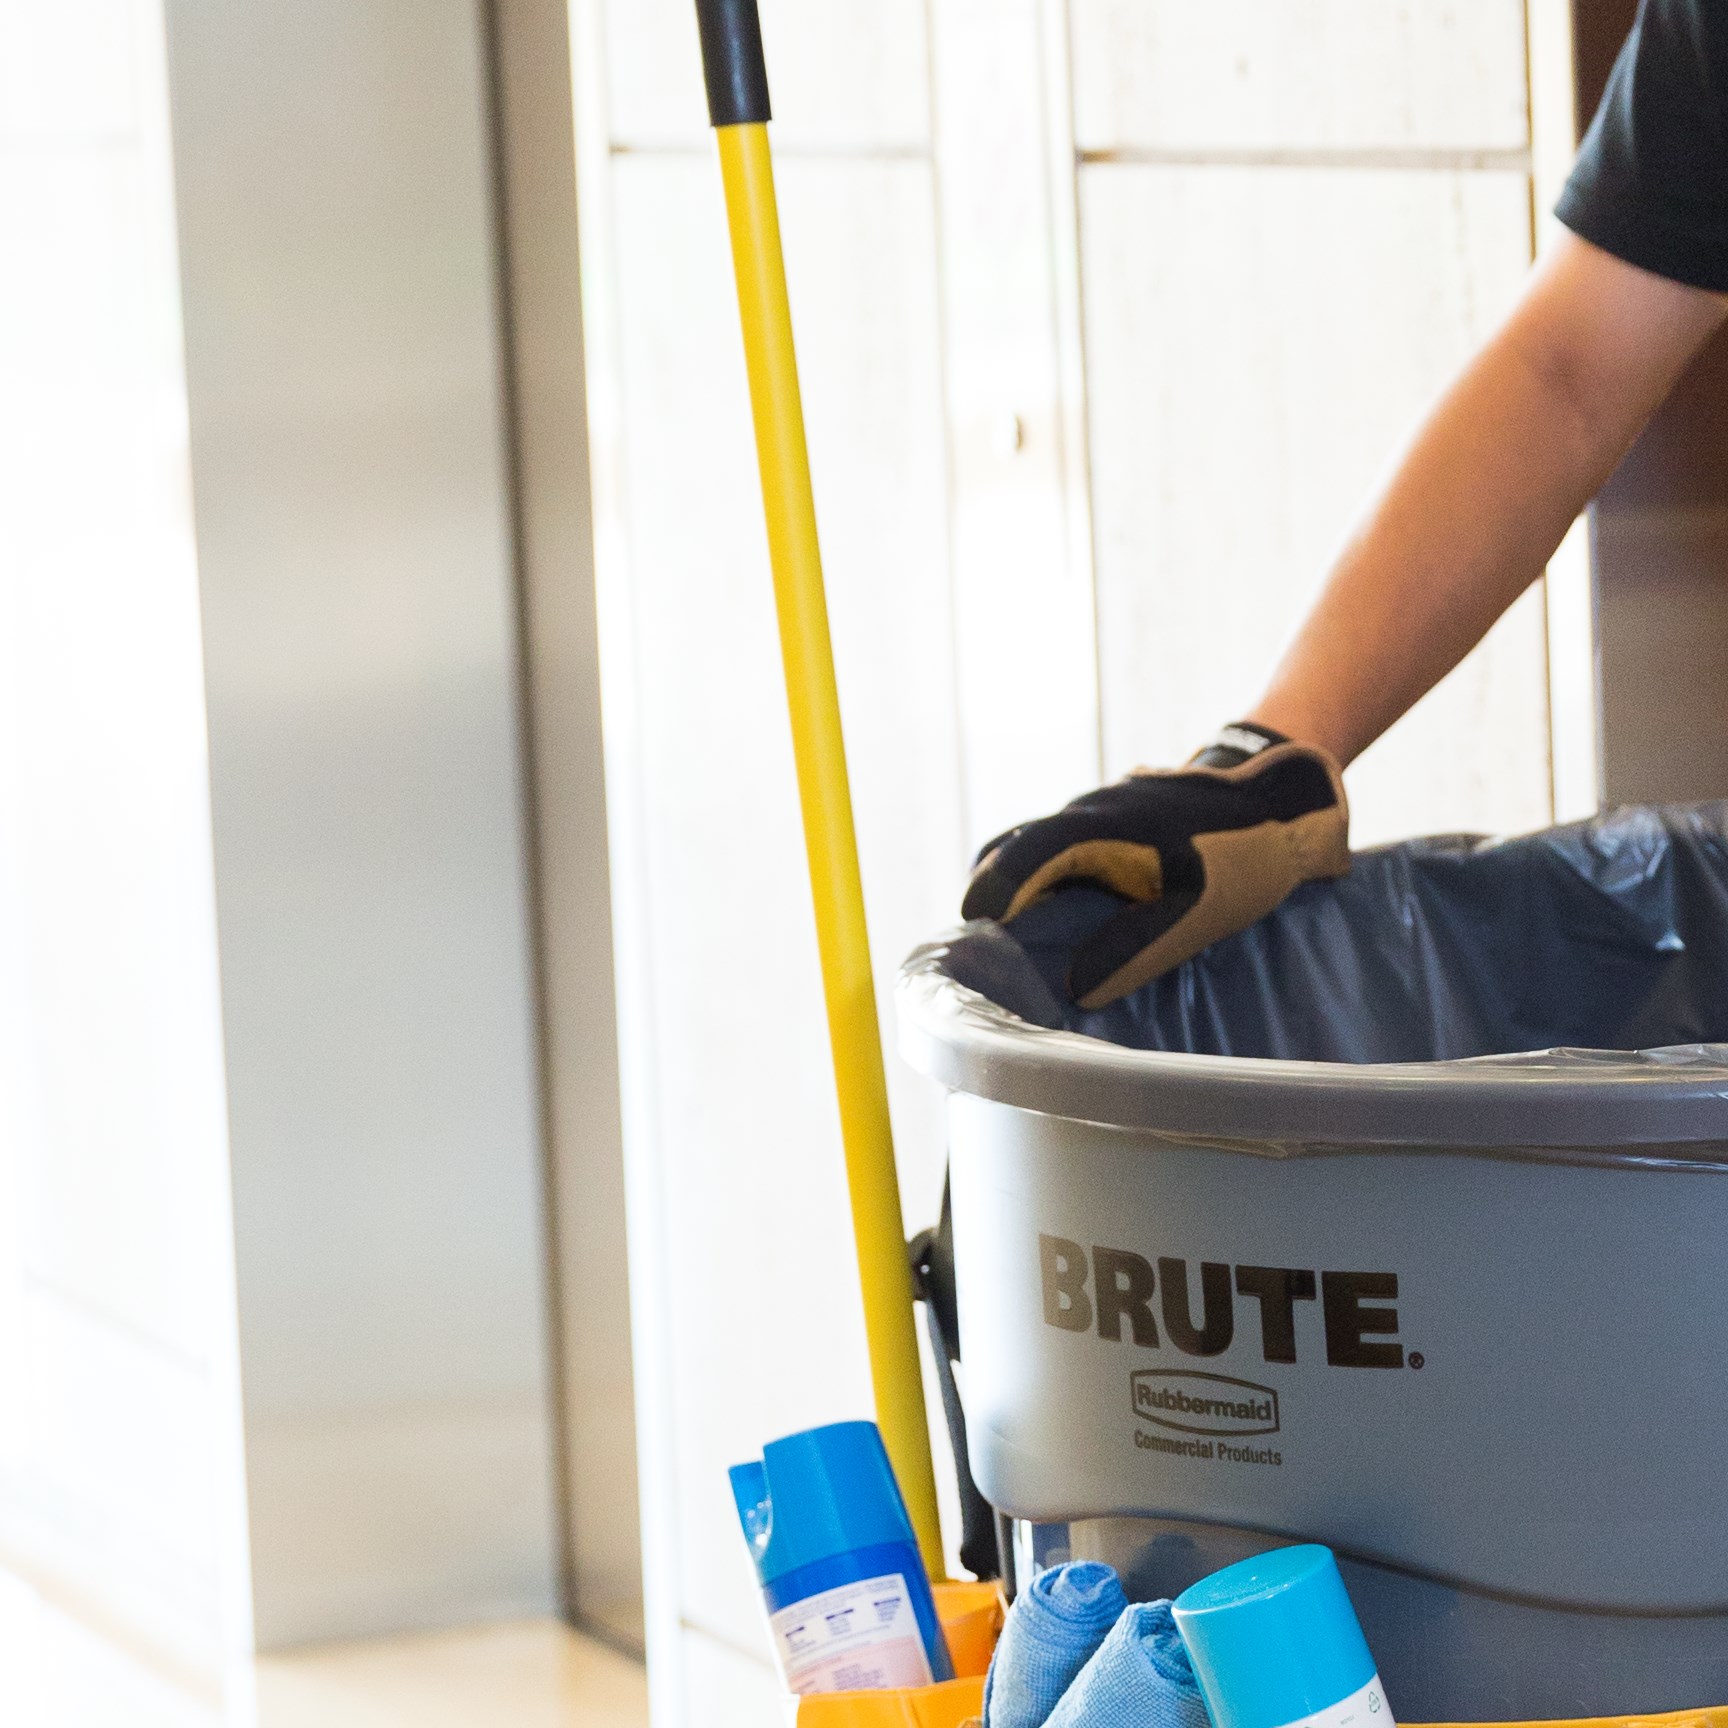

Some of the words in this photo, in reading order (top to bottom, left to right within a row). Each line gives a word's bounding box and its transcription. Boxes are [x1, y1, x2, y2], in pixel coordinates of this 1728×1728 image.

[1038, 1232, 1404, 1369] BRUTE
[1136, 1383, 1272, 1421] Rubbermaid
[1134, 1429, 1214, 1459] Commercial
[1217, 1442, 1282, 1466] Products
